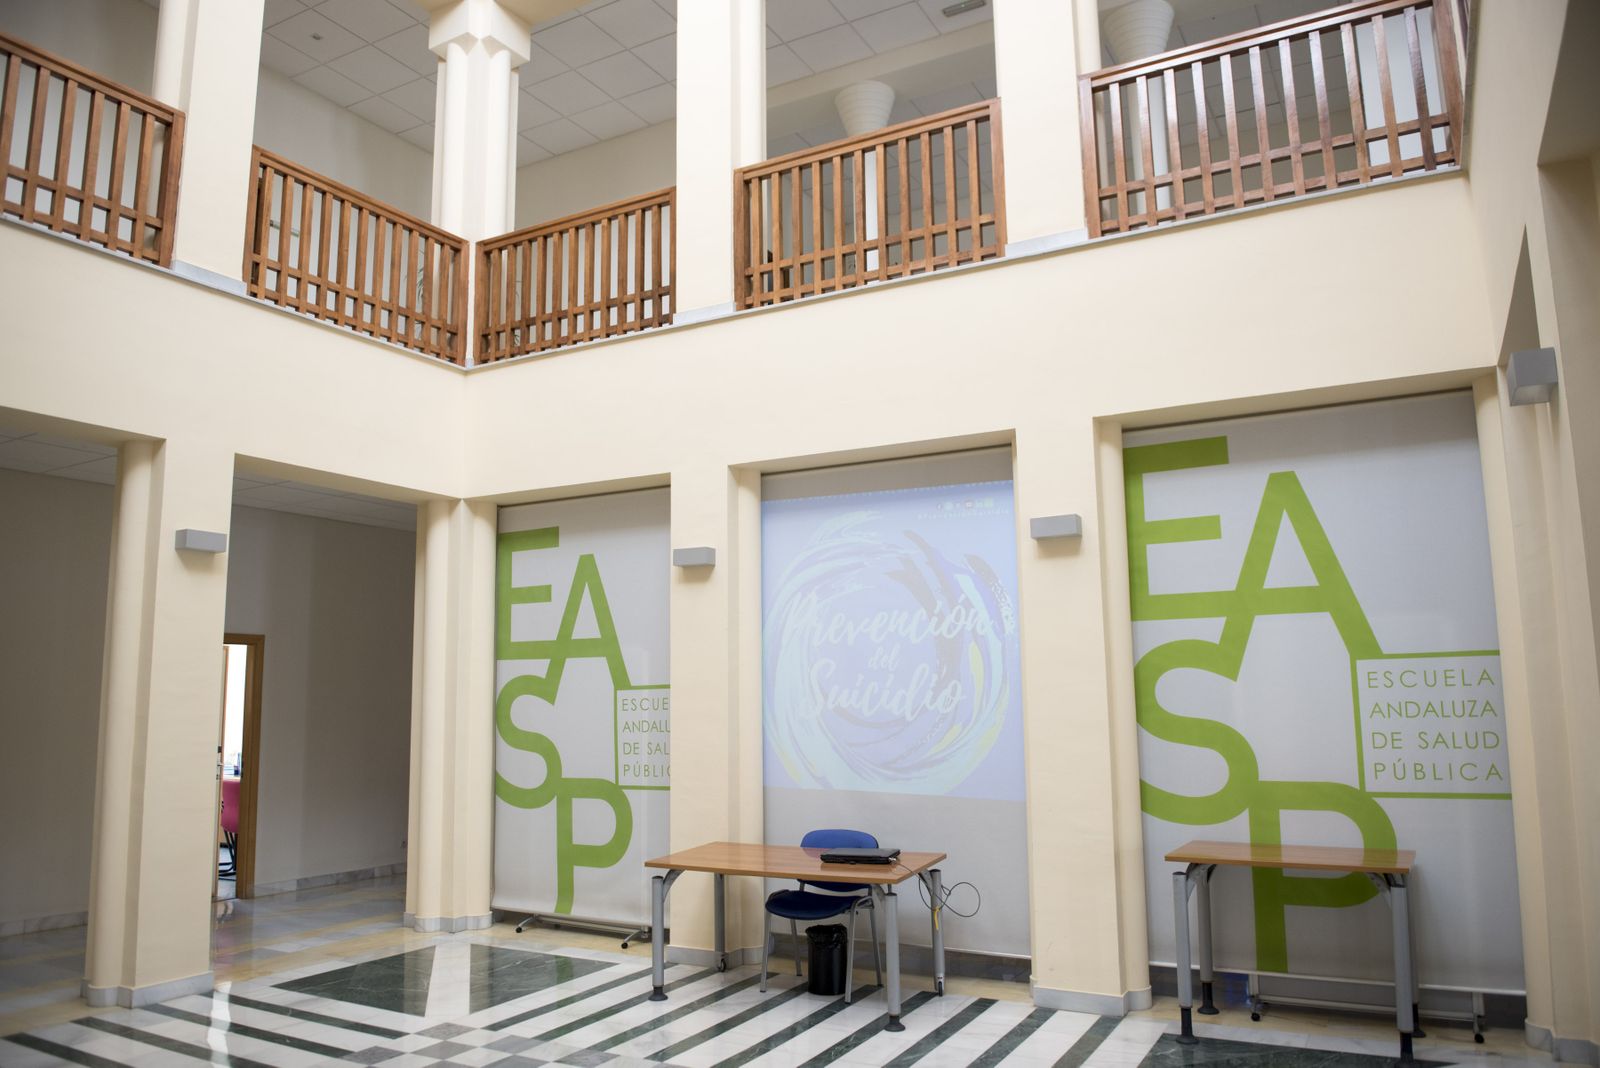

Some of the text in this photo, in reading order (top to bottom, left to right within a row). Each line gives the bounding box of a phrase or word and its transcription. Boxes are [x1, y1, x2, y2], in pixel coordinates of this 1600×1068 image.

[787, 591, 992, 647] Prevención
[867, 643, 900, 671] del
[1367, 668, 1495, 688] ESCUELA
[799, 658, 966, 722] Suicidio
[1369, 699, 1498, 719] ANDALUZA
[623, 742, 640, 755] DE
[1371, 731, 1500, 750] DE SALUD
[1374, 758, 1503, 781] PÚBLICA
